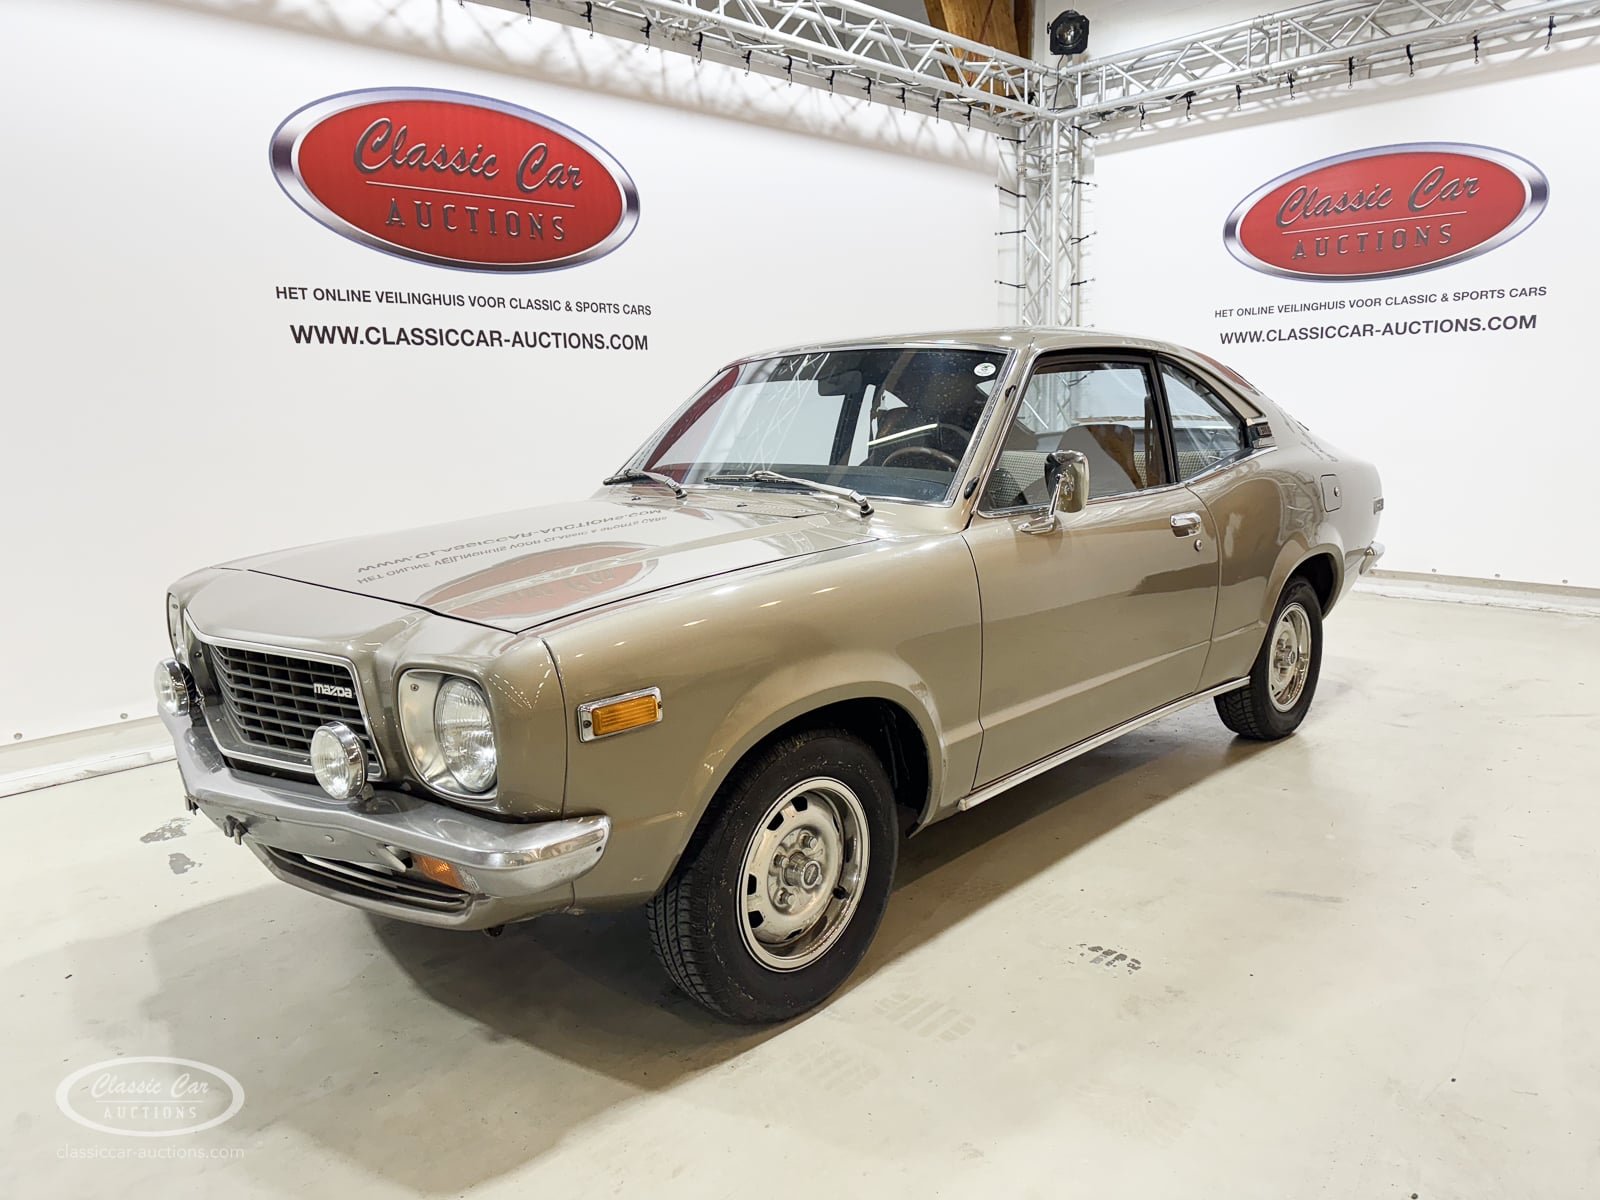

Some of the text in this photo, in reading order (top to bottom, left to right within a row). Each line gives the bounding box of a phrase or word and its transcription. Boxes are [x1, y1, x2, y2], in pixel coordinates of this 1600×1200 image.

[353, 117, 584, 193] Classic Car
[1275, 165, 1481, 228] Classic Car
[385, 197, 566, 241] AUCTIONS
[1291, 223, 1454, 261] AUCTIONS
[275, 286, 652, 316] HET ONLINE VEILINGHUIS VOOR CLASSIC & SPORTS CARS
[1214, 286, 1548, 318] HET ONLINE VEILINGHUIS VOOR CLASSIC & SPORTS CARS
[289, 324, 649, 351] WWW.CLASSICCAR-AUCTIONS.COM
[1219, 314, 1537, 345] WWW.CLASSICCAR-AUCTIONS.COM
